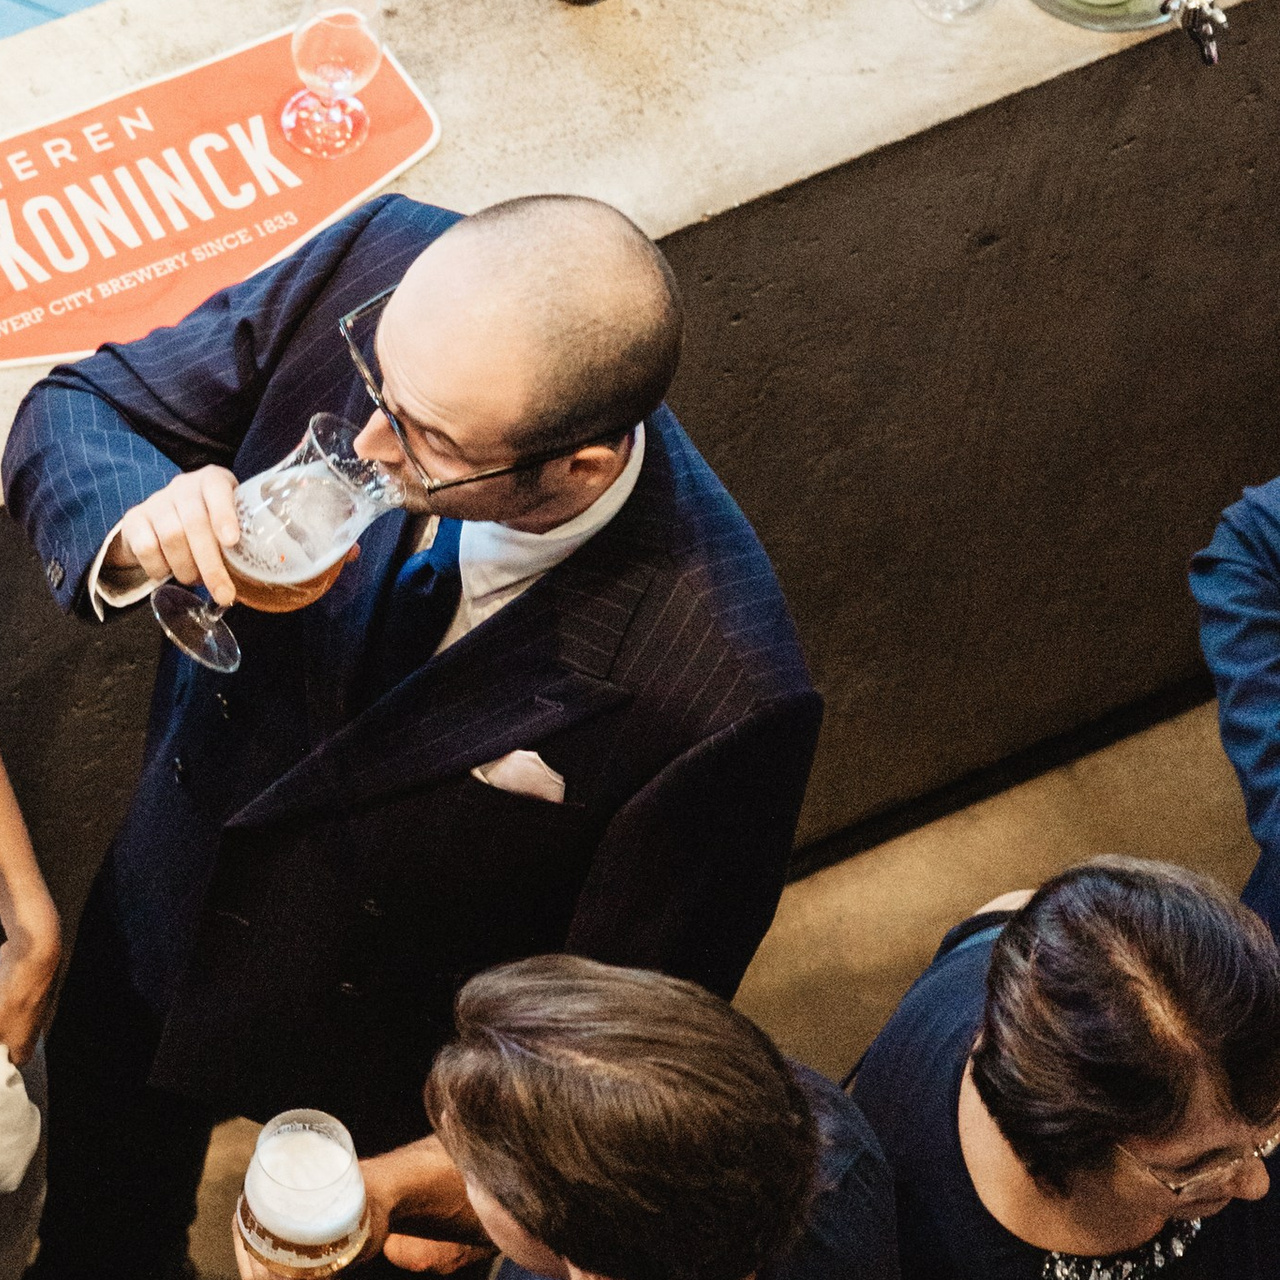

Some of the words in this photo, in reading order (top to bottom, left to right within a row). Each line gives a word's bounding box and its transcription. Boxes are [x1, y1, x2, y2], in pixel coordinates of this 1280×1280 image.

[49, 287, 95, 316] CITY
[96, 252, 189, 299] BREWERY
[191, 228, 253, 262] SINCE
[254, 210, 299, 238] 1833
